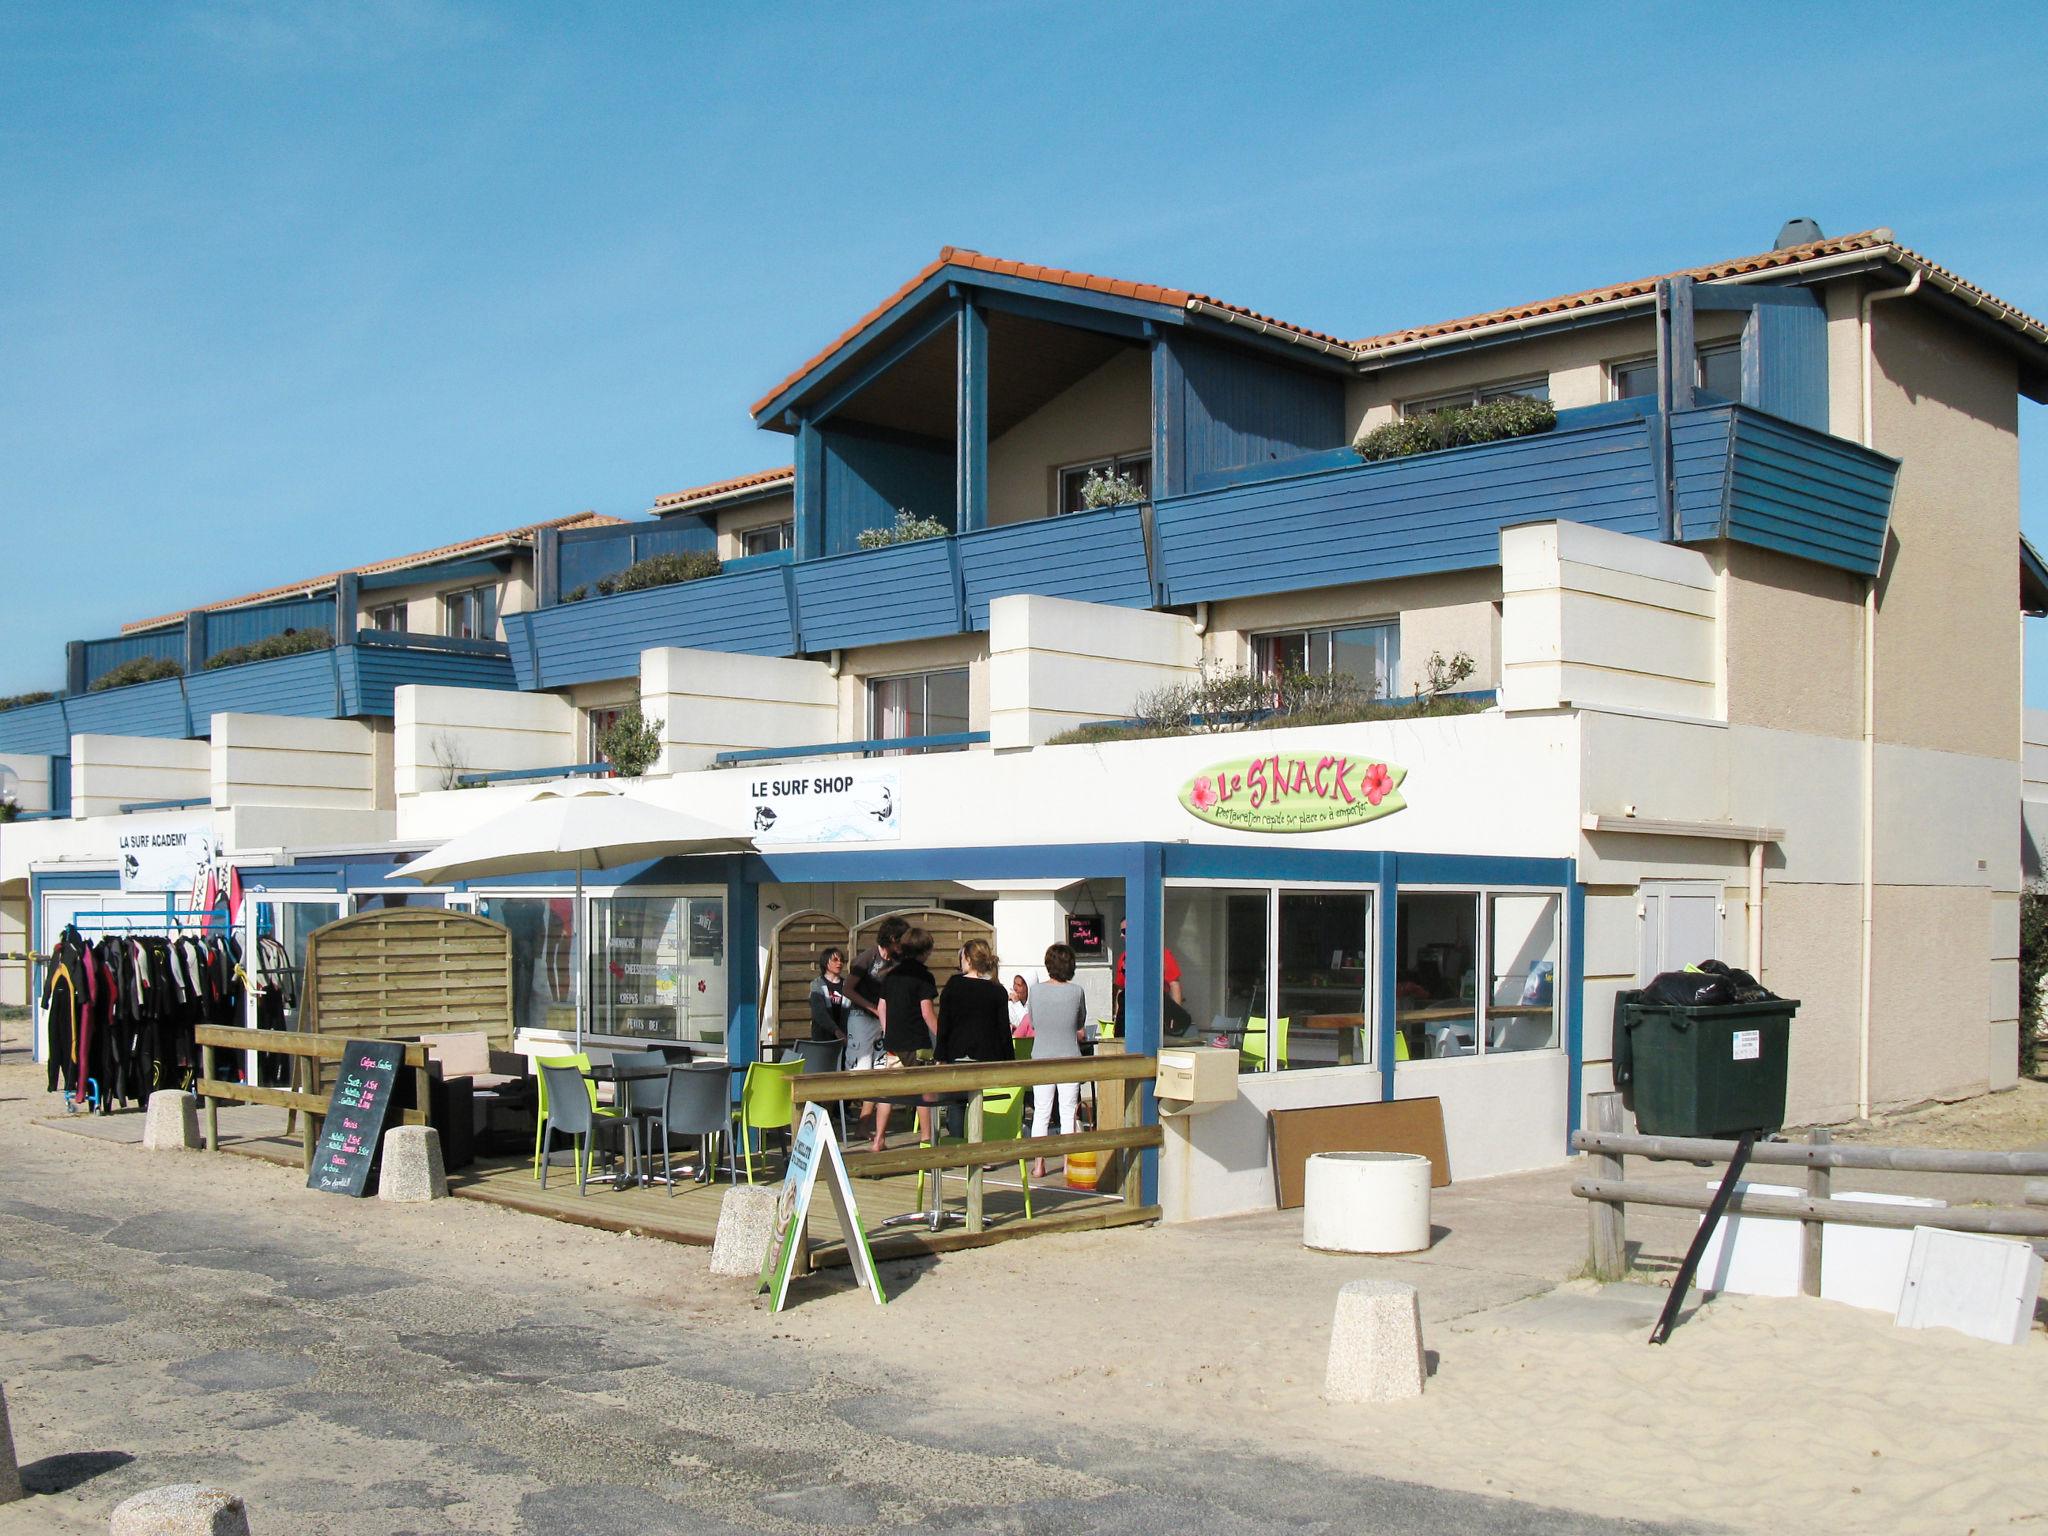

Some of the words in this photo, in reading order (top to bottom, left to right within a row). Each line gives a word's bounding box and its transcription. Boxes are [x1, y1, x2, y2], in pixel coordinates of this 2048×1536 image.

[752, 782, 768, 798] LE
[772, 779, 809, 797] SURF
[814, 776, 854, 794] SHOP
[1217, 772, 1242, 802] Le
[1247, 754, 1357, 809] SNACK
[1215, 806, 1261, 827] Restauration
[1262, 811, 1285, 831] rapide
[1286, 814, 1298, 825] sur
[1299, 811, 1318, 830] place
[1320, 813, 1327, 822] ou
[1328, 806, 1334, 820] à
[1336, 801, 1368, 823] emporter
[120, 836, 129, 849] LA
[130, 835, 150, 848] SURF
[151, 833, 187, 847] ACADEMY
